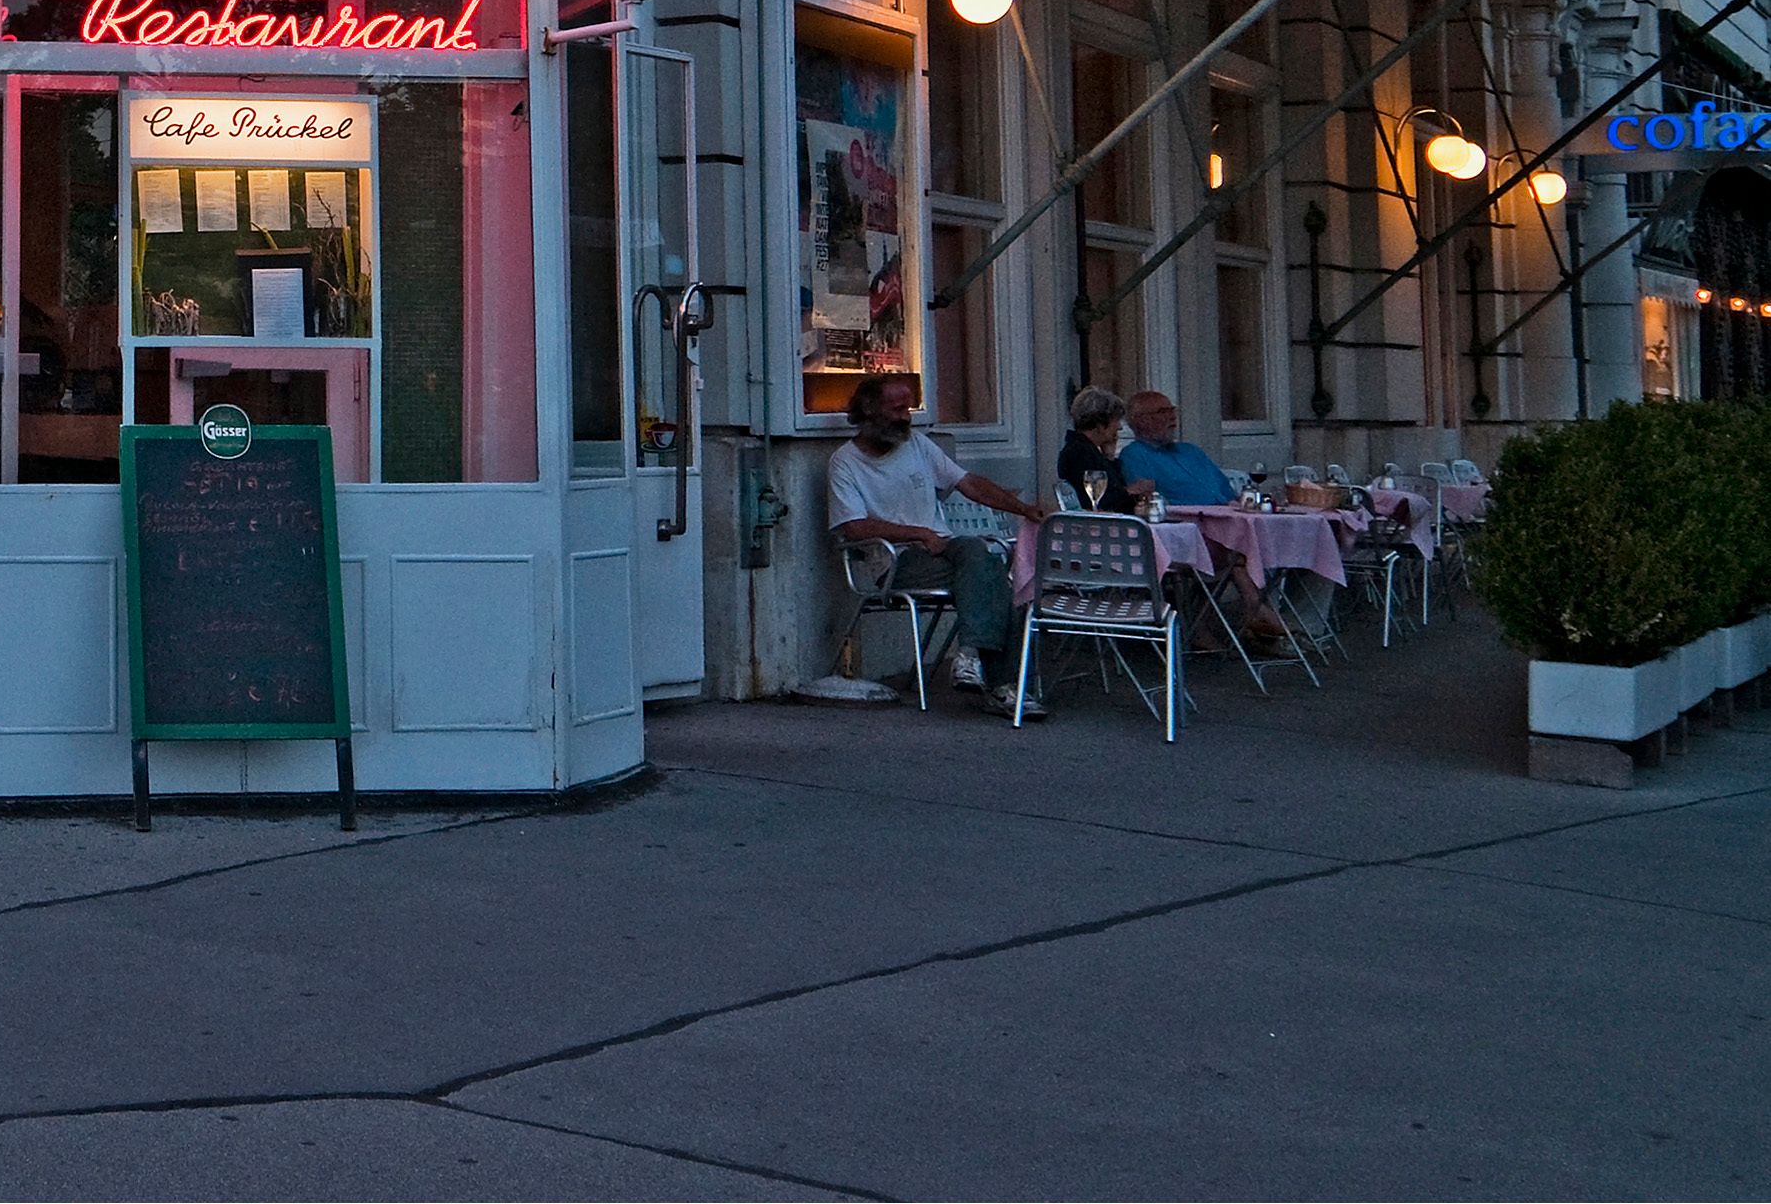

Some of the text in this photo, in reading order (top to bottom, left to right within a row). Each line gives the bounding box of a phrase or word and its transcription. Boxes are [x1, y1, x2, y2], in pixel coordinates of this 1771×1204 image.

[143, 106, 354, 146] Cafe Prückel
[203, 421, 248, 440] Gösser
